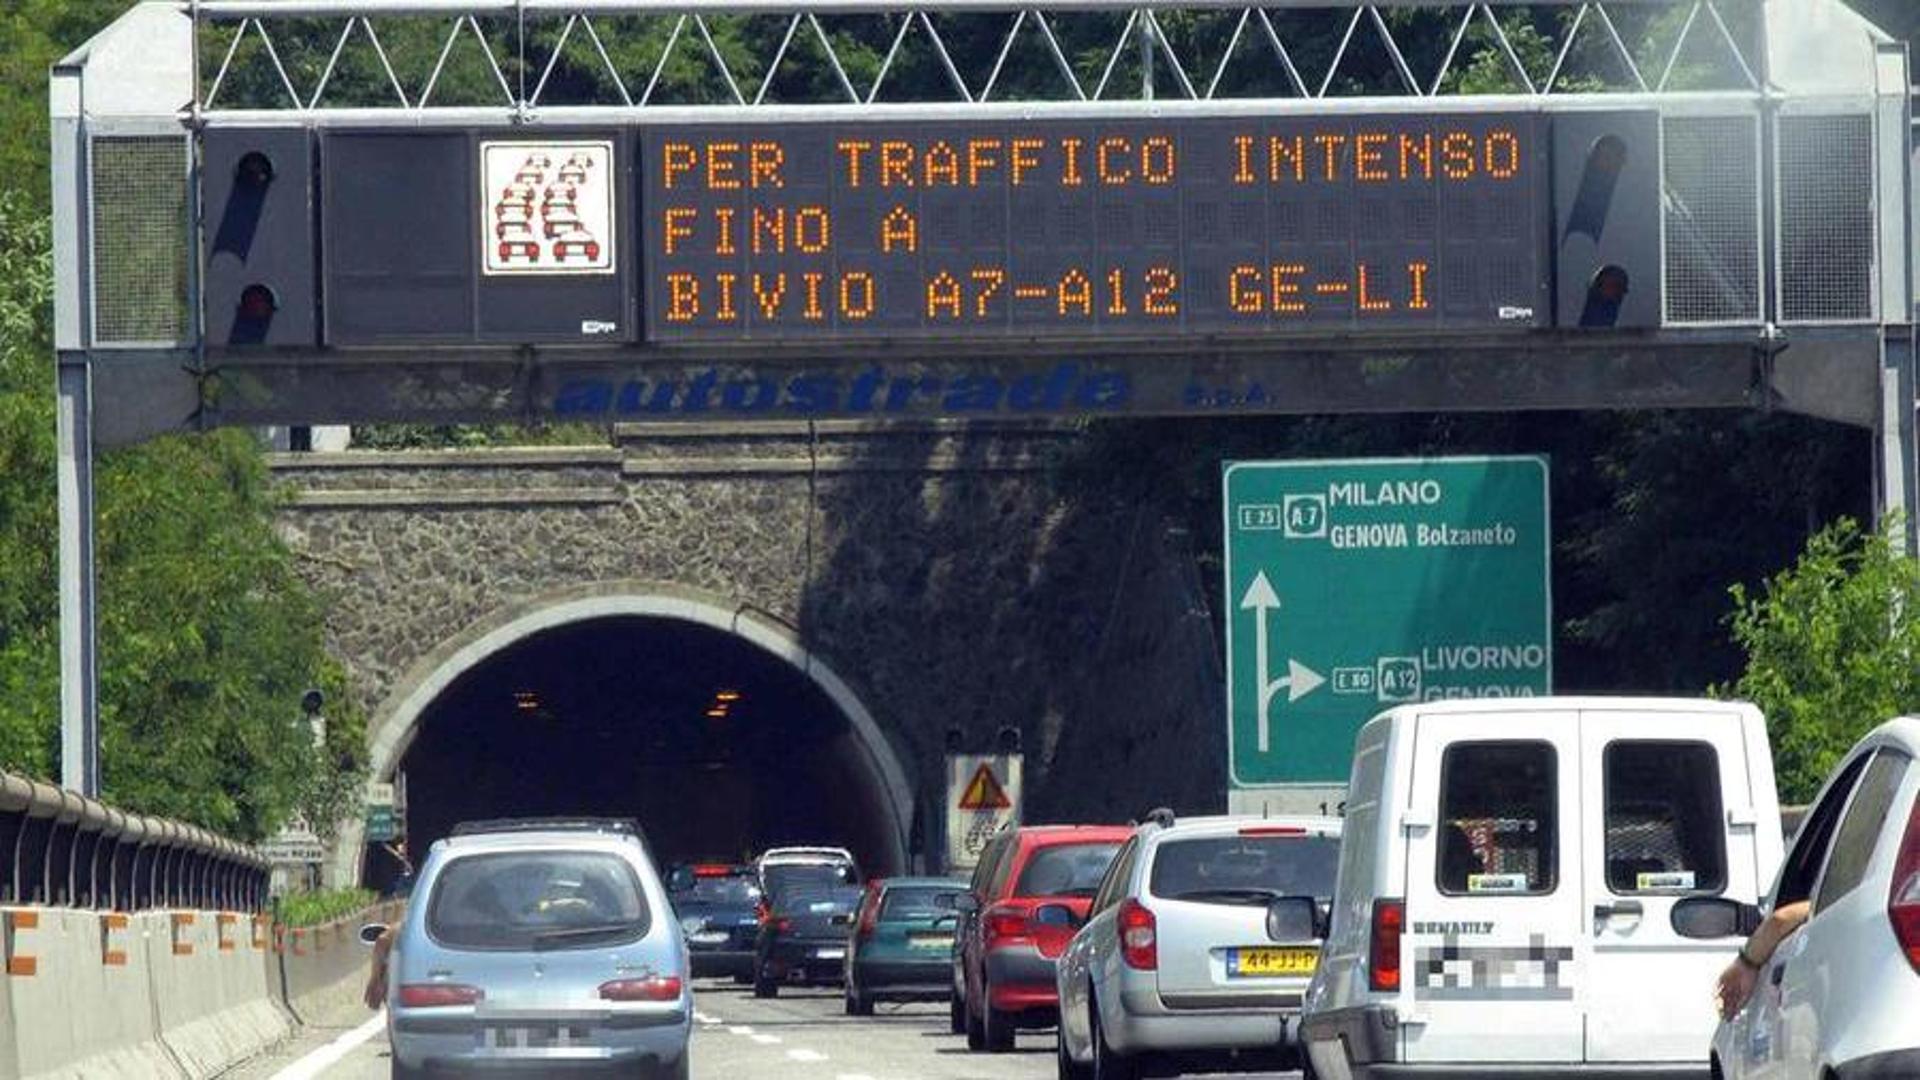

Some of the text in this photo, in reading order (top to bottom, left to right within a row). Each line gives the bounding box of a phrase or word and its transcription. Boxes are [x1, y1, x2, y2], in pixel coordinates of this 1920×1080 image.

[663, 132, 1520, 189] PER TRAFFICO INTENSO
[664, 205, 919, 256] FINO A
[667, 263, 1429, 321] BIVIO A7-A12 GE-LI
[556, 366, 1131, 413] autostrade
[1329, 480, 1442, 506] MILANO
[1330, 522, 1516, 549] GENOVA Bolzaneto
[1422, 644, 1544, 670] LIVORNO
